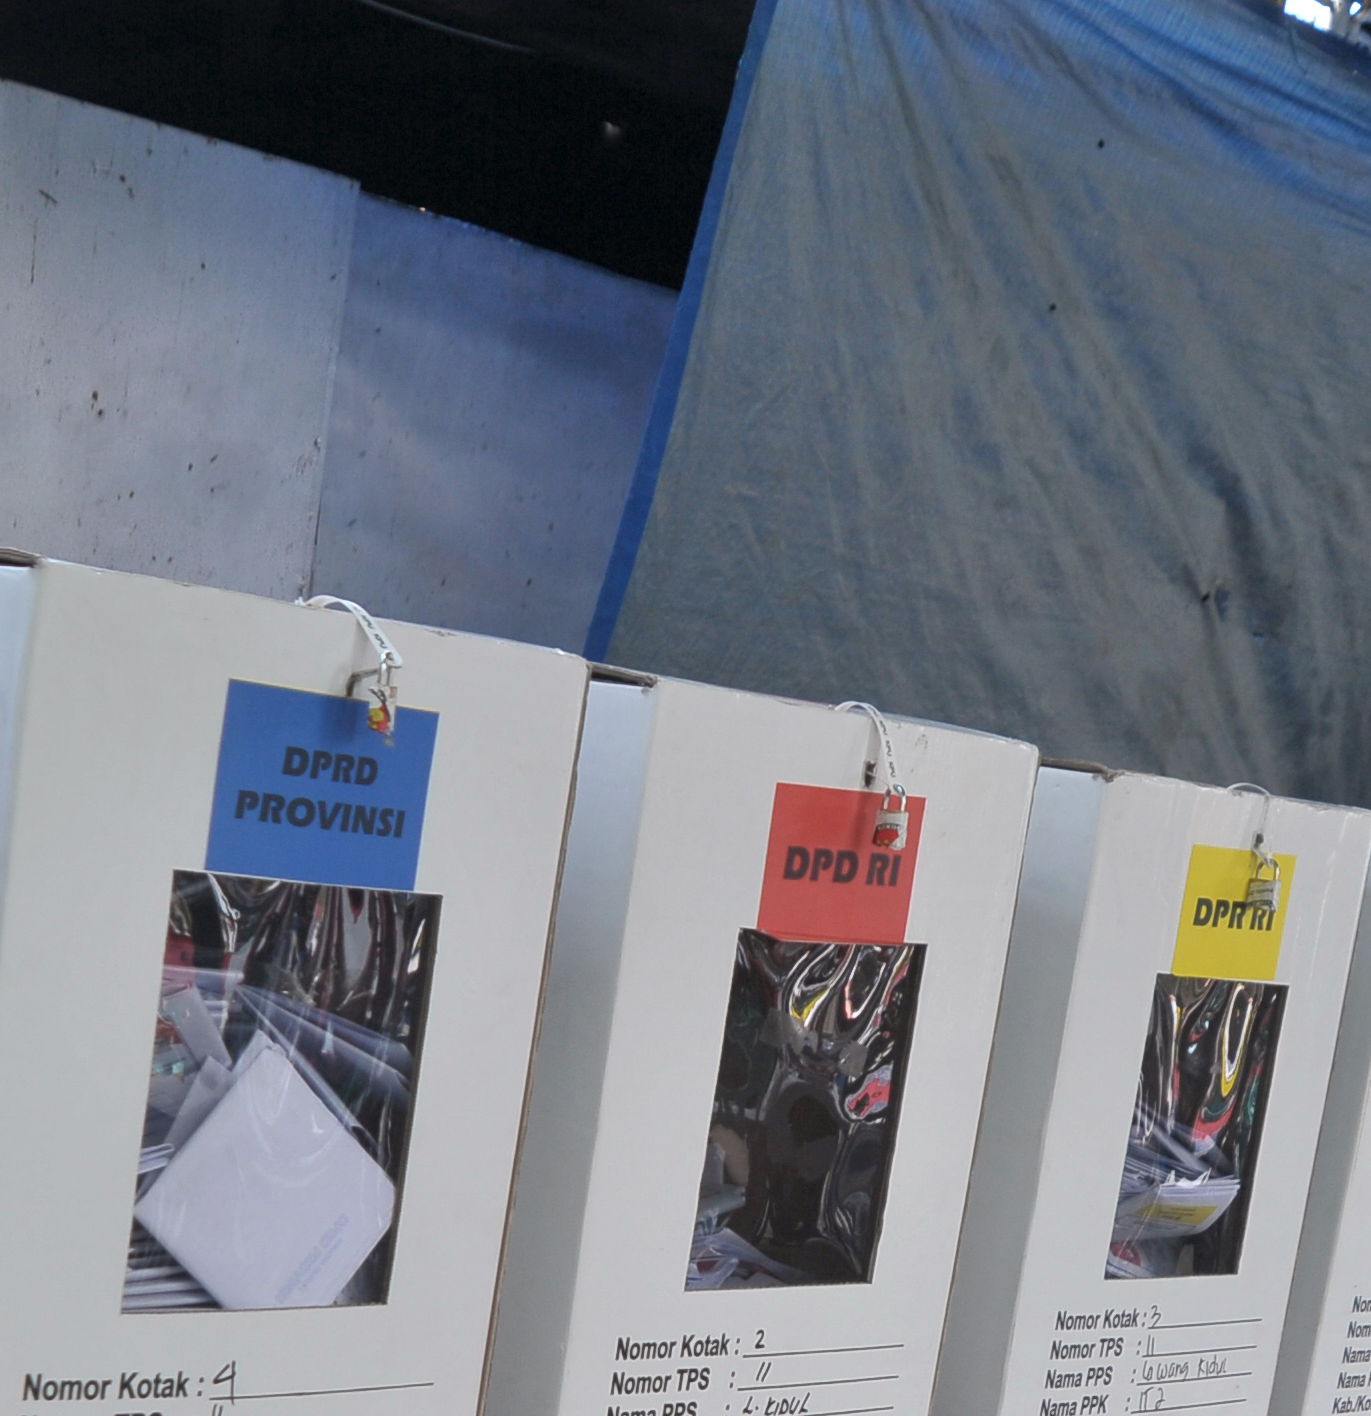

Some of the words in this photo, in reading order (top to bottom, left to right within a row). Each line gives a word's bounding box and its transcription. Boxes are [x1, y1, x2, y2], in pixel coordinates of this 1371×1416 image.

[282, 746, 379, 786] DPRD
[234, 789, 406, 838] PROVINSI
[783, 846, 858, 884] DPD
[865, 853, 901, 886] RI
[1193, 897, 1247, 929] DPR
[1249, 905, 1275, 931] RI
[1055, 1310, 1101, 1331] Nomor
[1103, 1308, 1139, 1329] Kotak
[1151, 1305, 1162, 1328] 3
[615, 1337, 676, 1361] Nomor
[680, 1333, 731, 1358] Kotak
[754, 1329, 765, 1349] 2
[1049, 1340, 1096, 1361] Nomor
[1099, 1337, 1124, 1358] TPS
[1342, 1346, 1370, 1364] Nama
[22, 1373, 111, 1401] Nomor
[118, 1370, 190, 1399] Kotak
[213, 1360, 236, 1404] 4
[610, 1372, 672, 1396] Nomor
[677, 1367, 711, 1392] TPS
[1044, 1368, 1081, 1389] Nama
[1085, 1366, 1113, 1387] PPS
[1337, 1372, 1366, 1389] Nama
[764, 1392, 811, 1416] KIDUL
[1081, 1394, 1109, 1415] PPK
